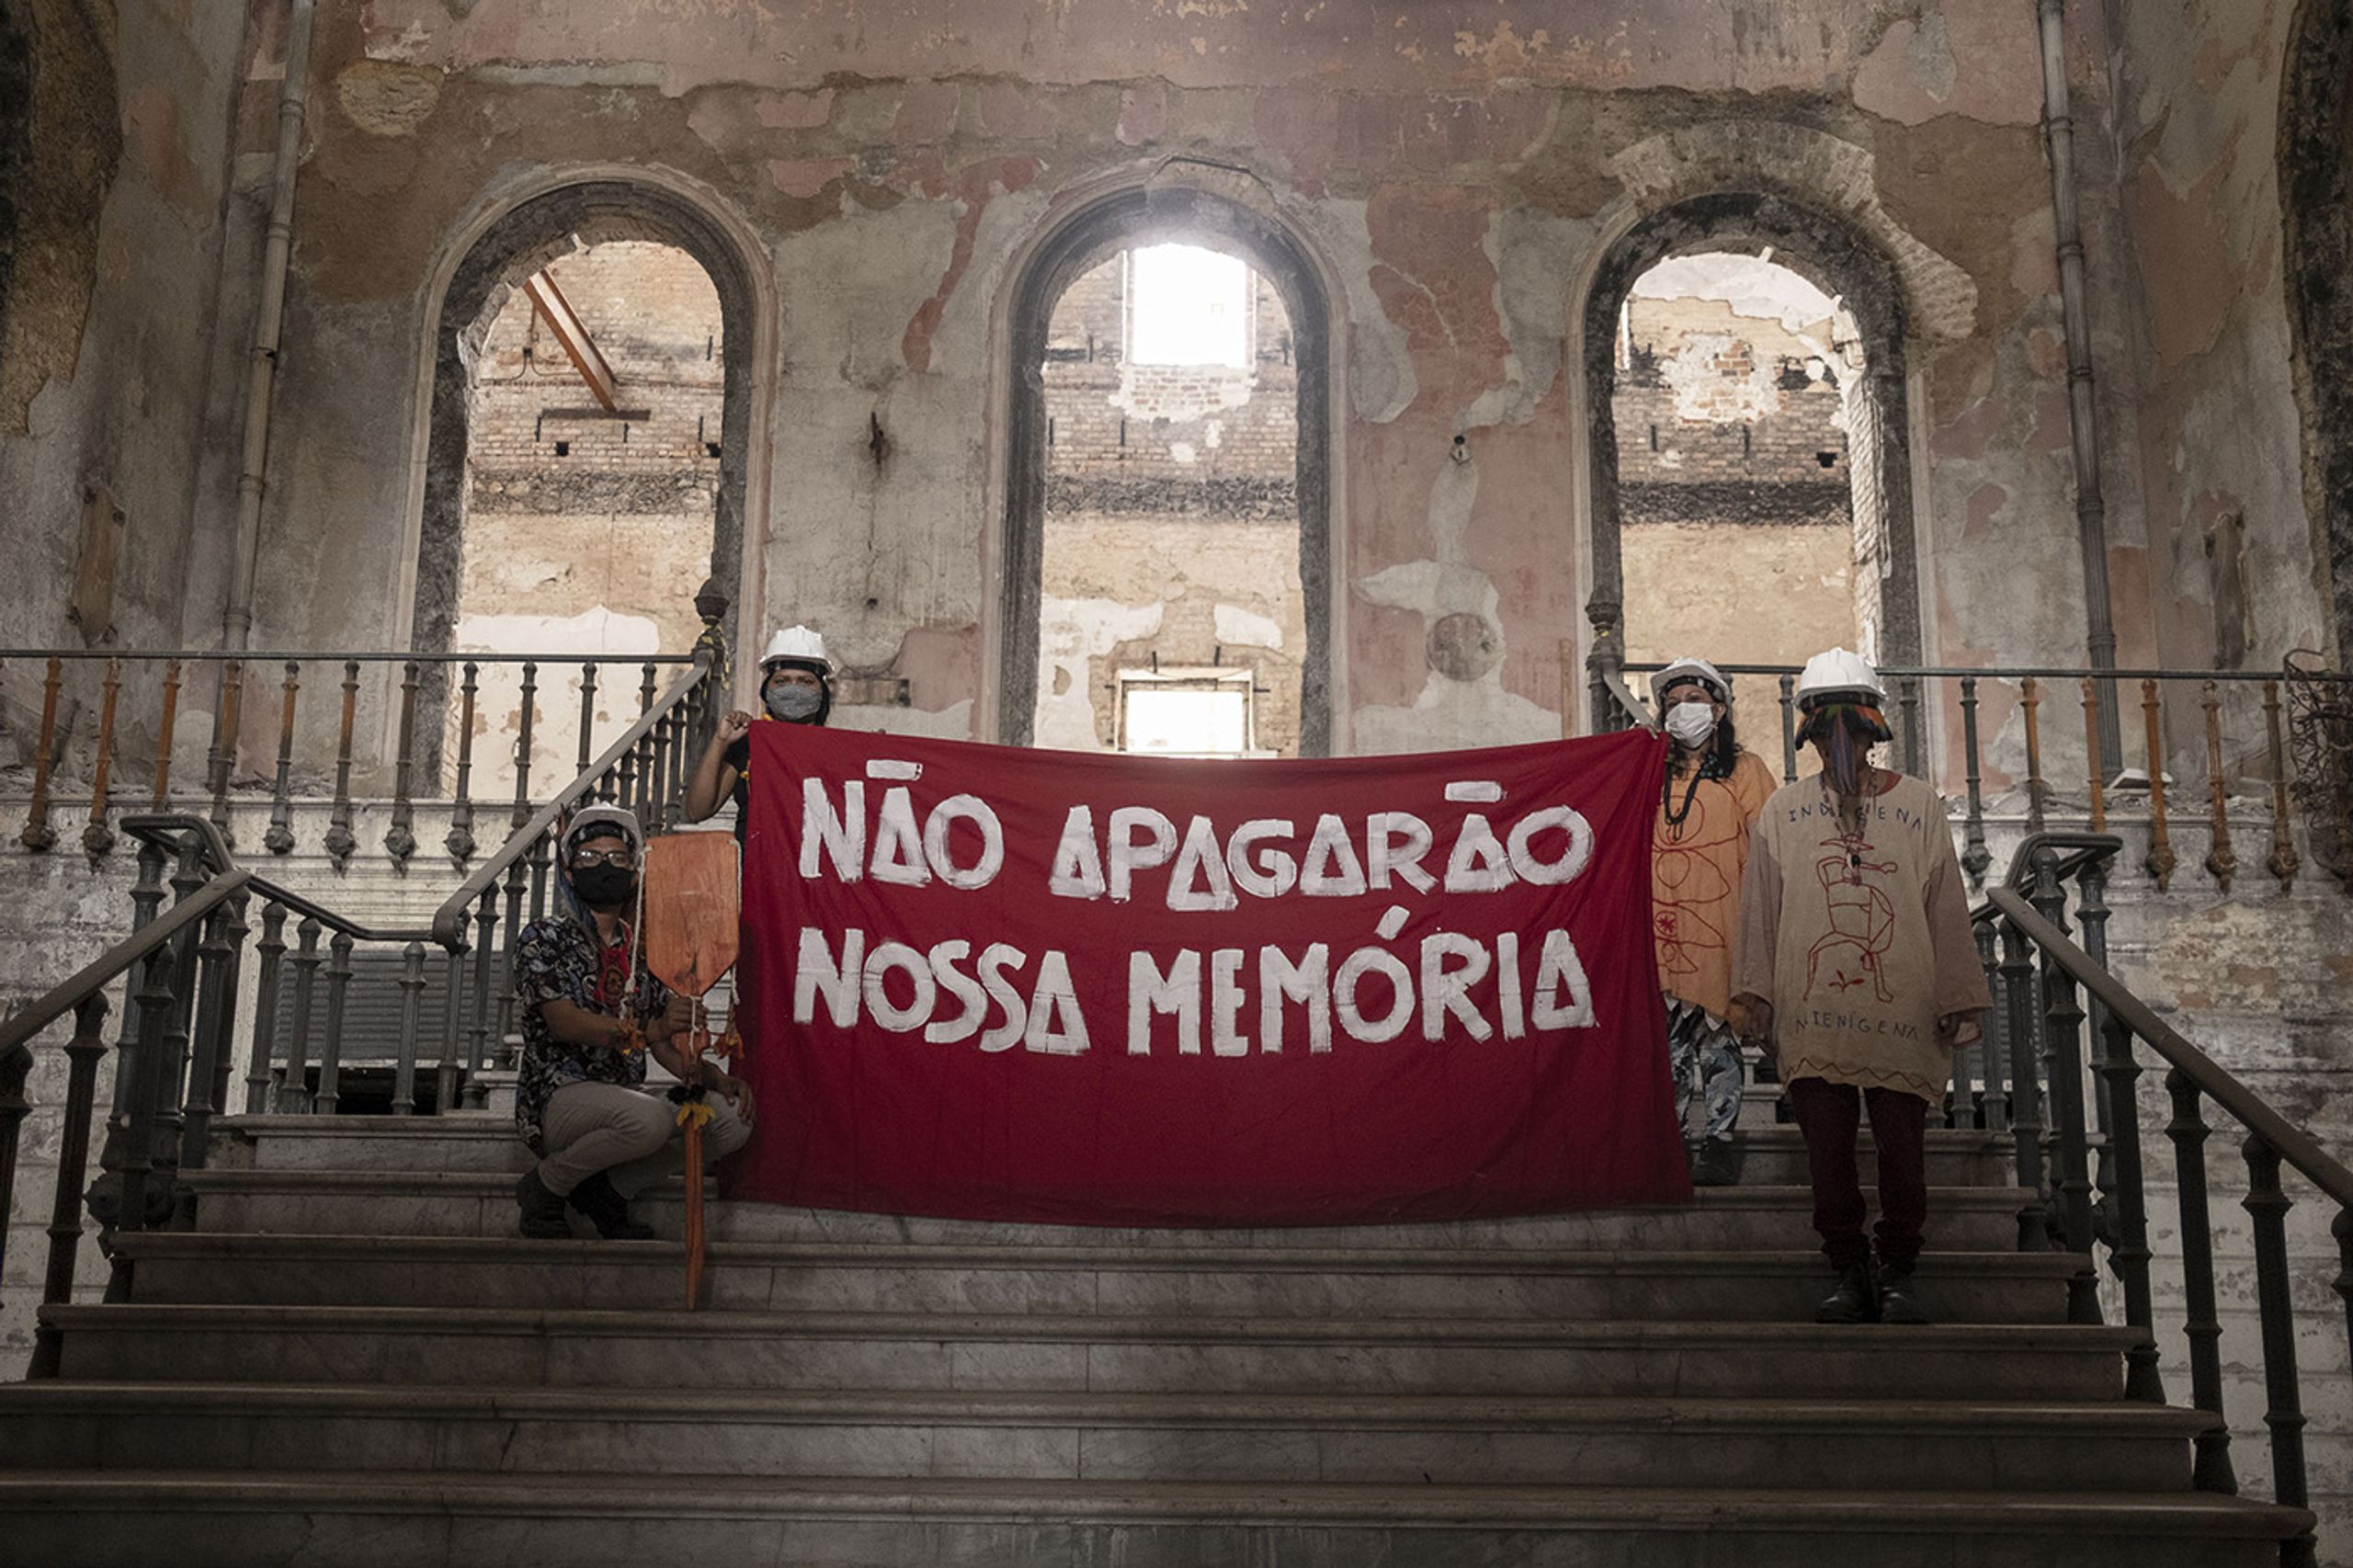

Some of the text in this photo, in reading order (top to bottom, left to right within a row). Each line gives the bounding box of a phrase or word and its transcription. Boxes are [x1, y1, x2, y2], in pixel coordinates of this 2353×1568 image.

[797, 758, 1595, 911] NÃO APAGARÃO
[793, 905, 1600, 1057] NOSSA MEMÓRIA
